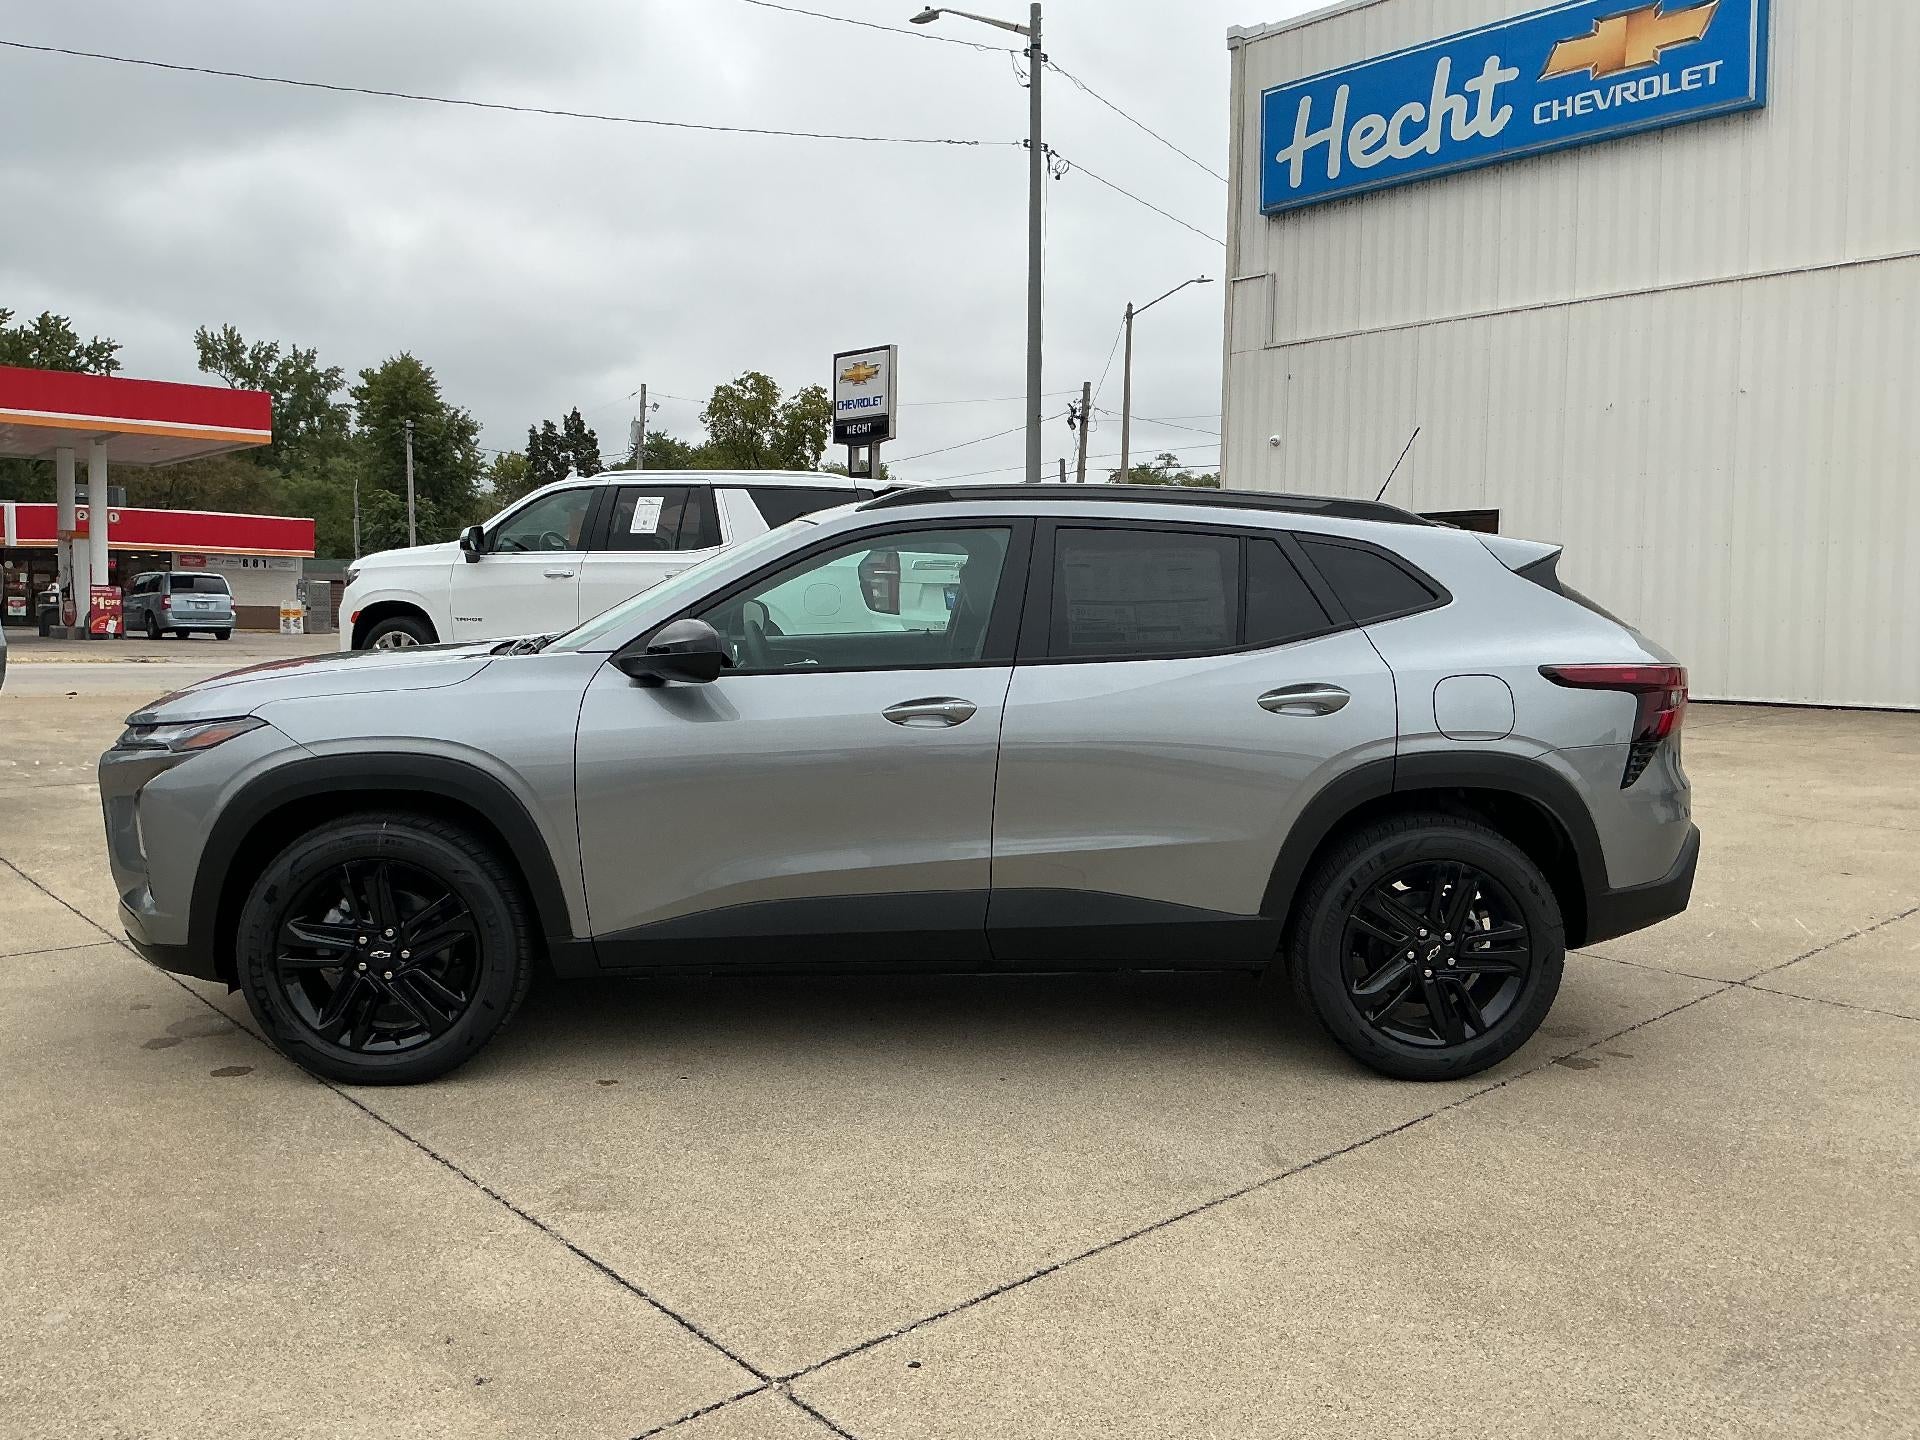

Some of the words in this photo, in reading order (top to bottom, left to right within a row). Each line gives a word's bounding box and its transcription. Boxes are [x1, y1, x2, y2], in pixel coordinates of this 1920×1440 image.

[1276, 55, 1520, 189] Hecht
[1533, 60, 1724, 125] CHEVROLET
[837, 395, 883, 411] CHEVROLET
[846, 422, 872, 435] HECHT
